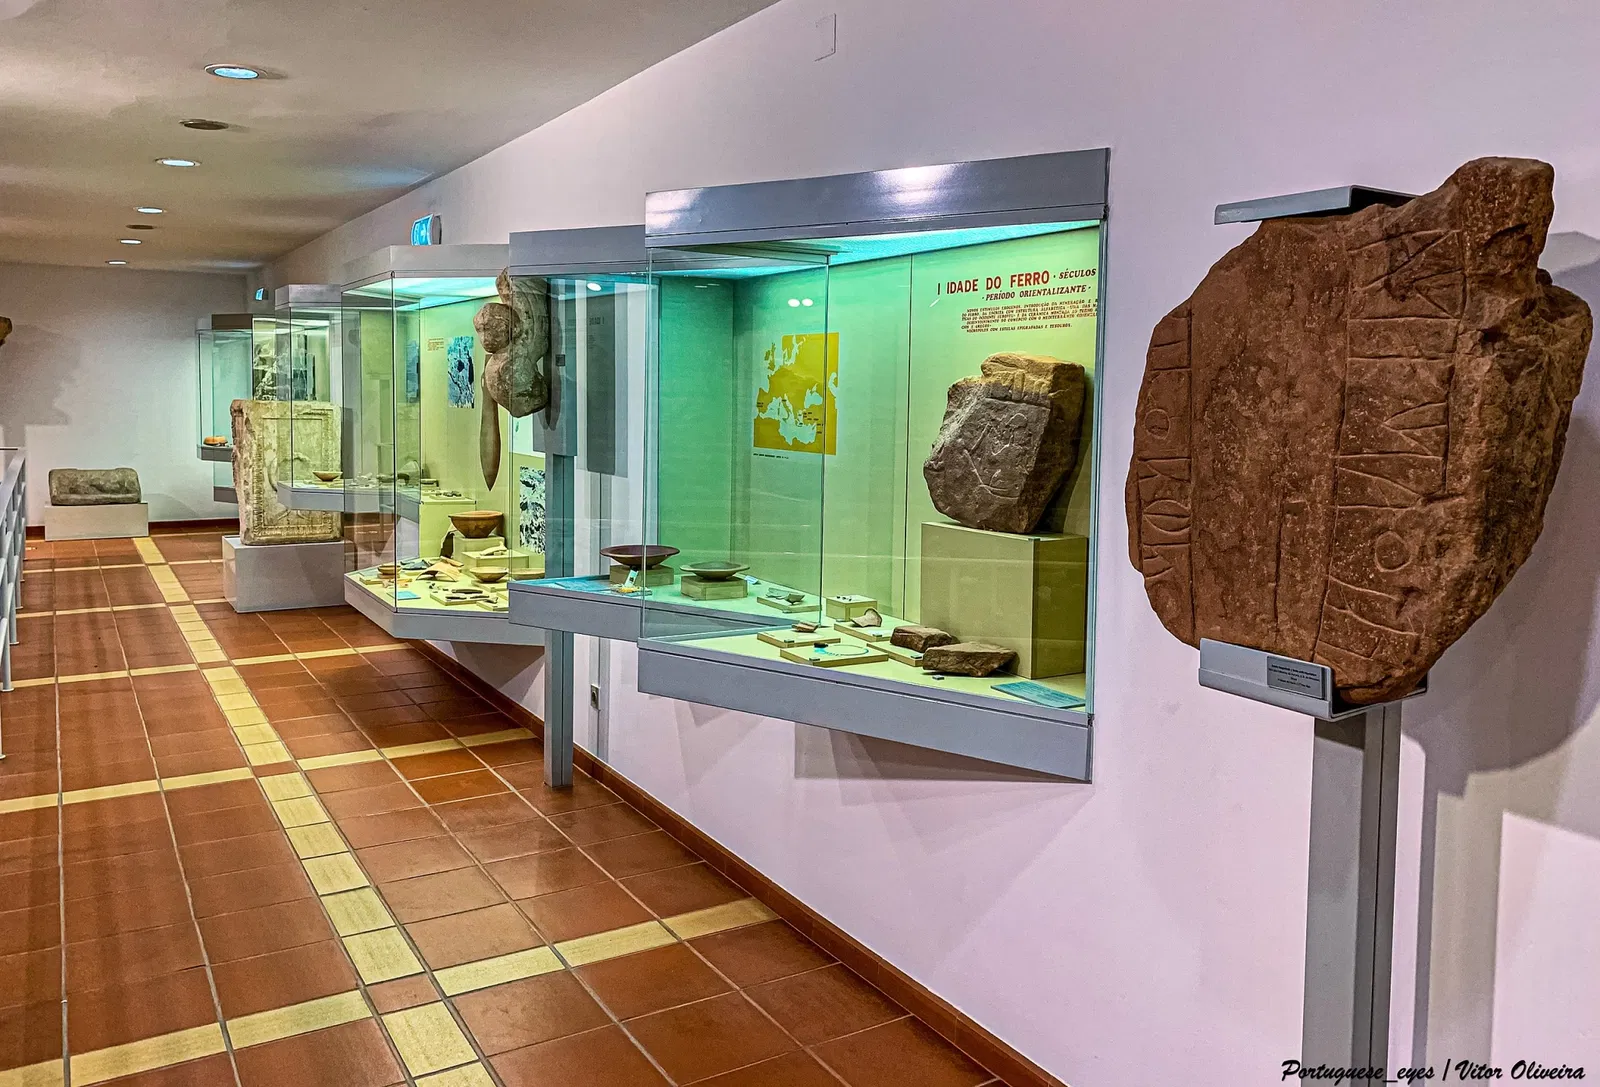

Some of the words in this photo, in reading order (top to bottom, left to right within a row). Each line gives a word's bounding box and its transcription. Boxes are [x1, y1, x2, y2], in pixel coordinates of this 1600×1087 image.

[947, 279, 978, 294] IDADE
[986, 276, 1002, 290] DO
[1010, 270, 1050, 288] FERRO
[1059, 268, 1097, 279] SÉCULOS
[986, 290, 1015, 301] PERÍODO
[1020, 285, 1087, 298] ORIENTALIZANTE
